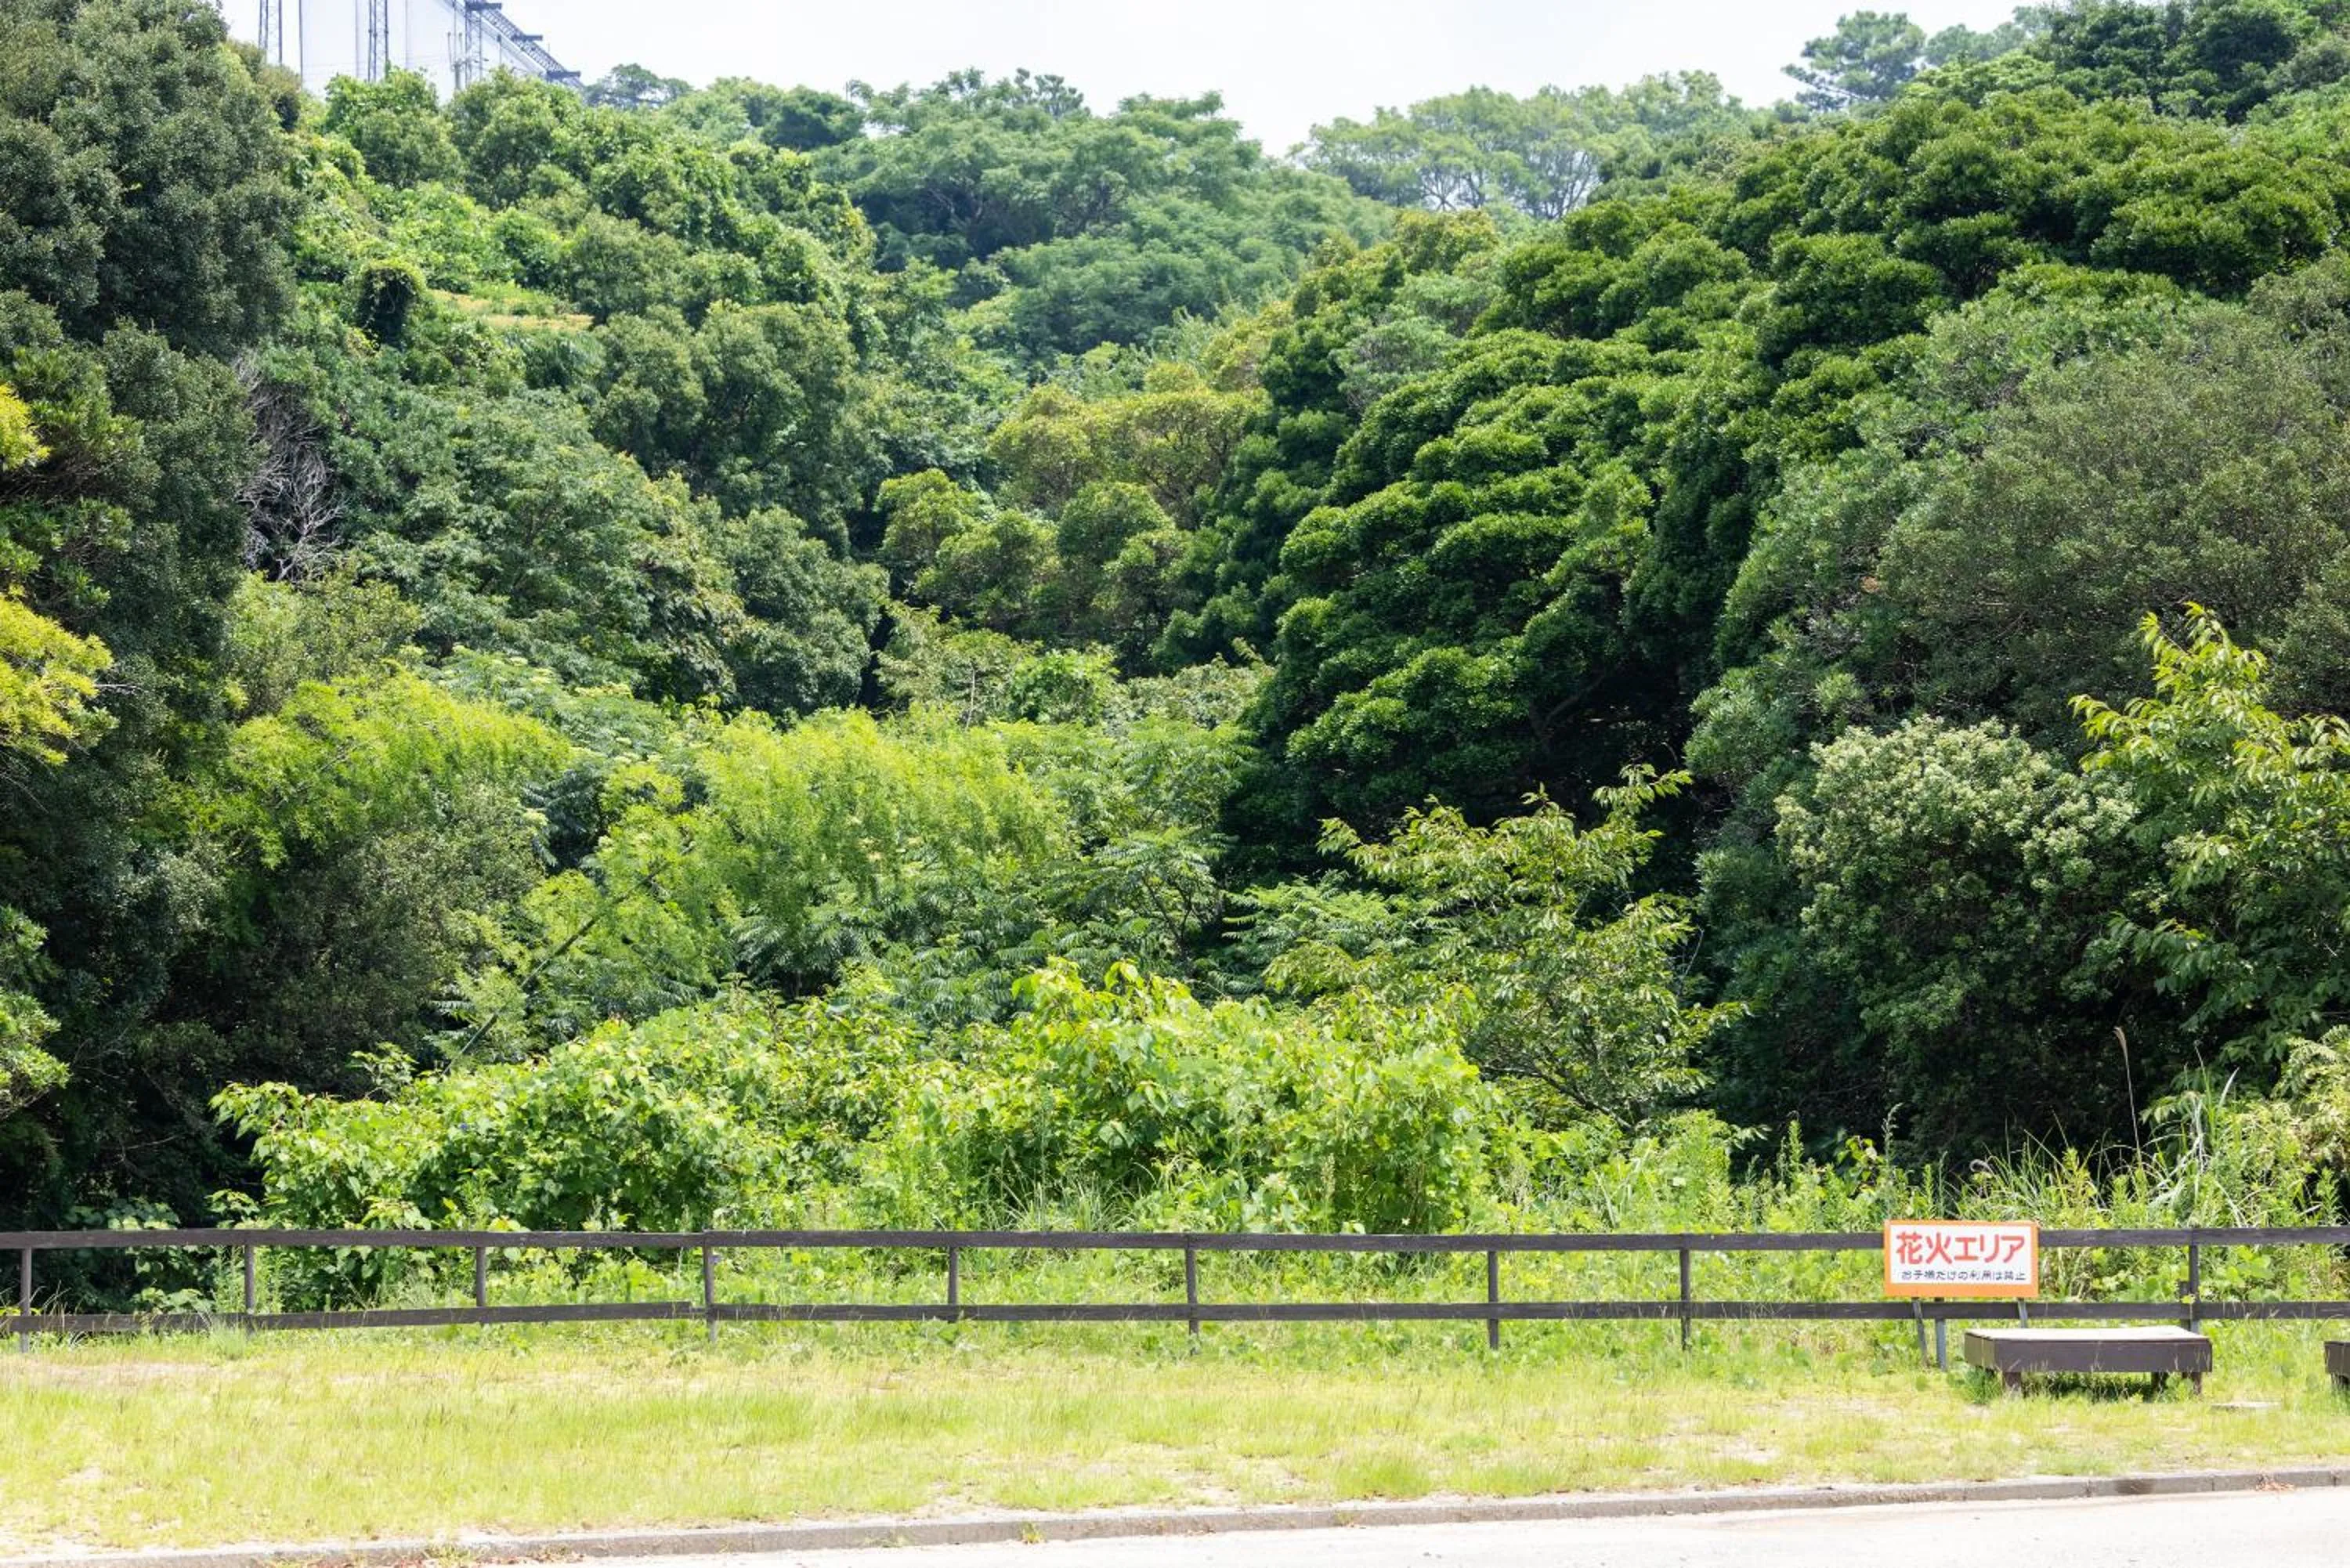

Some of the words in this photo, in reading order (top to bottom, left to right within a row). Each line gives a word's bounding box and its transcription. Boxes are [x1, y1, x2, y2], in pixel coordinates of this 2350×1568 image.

[1896, 1232, 2025, 1264] 花火エリア
